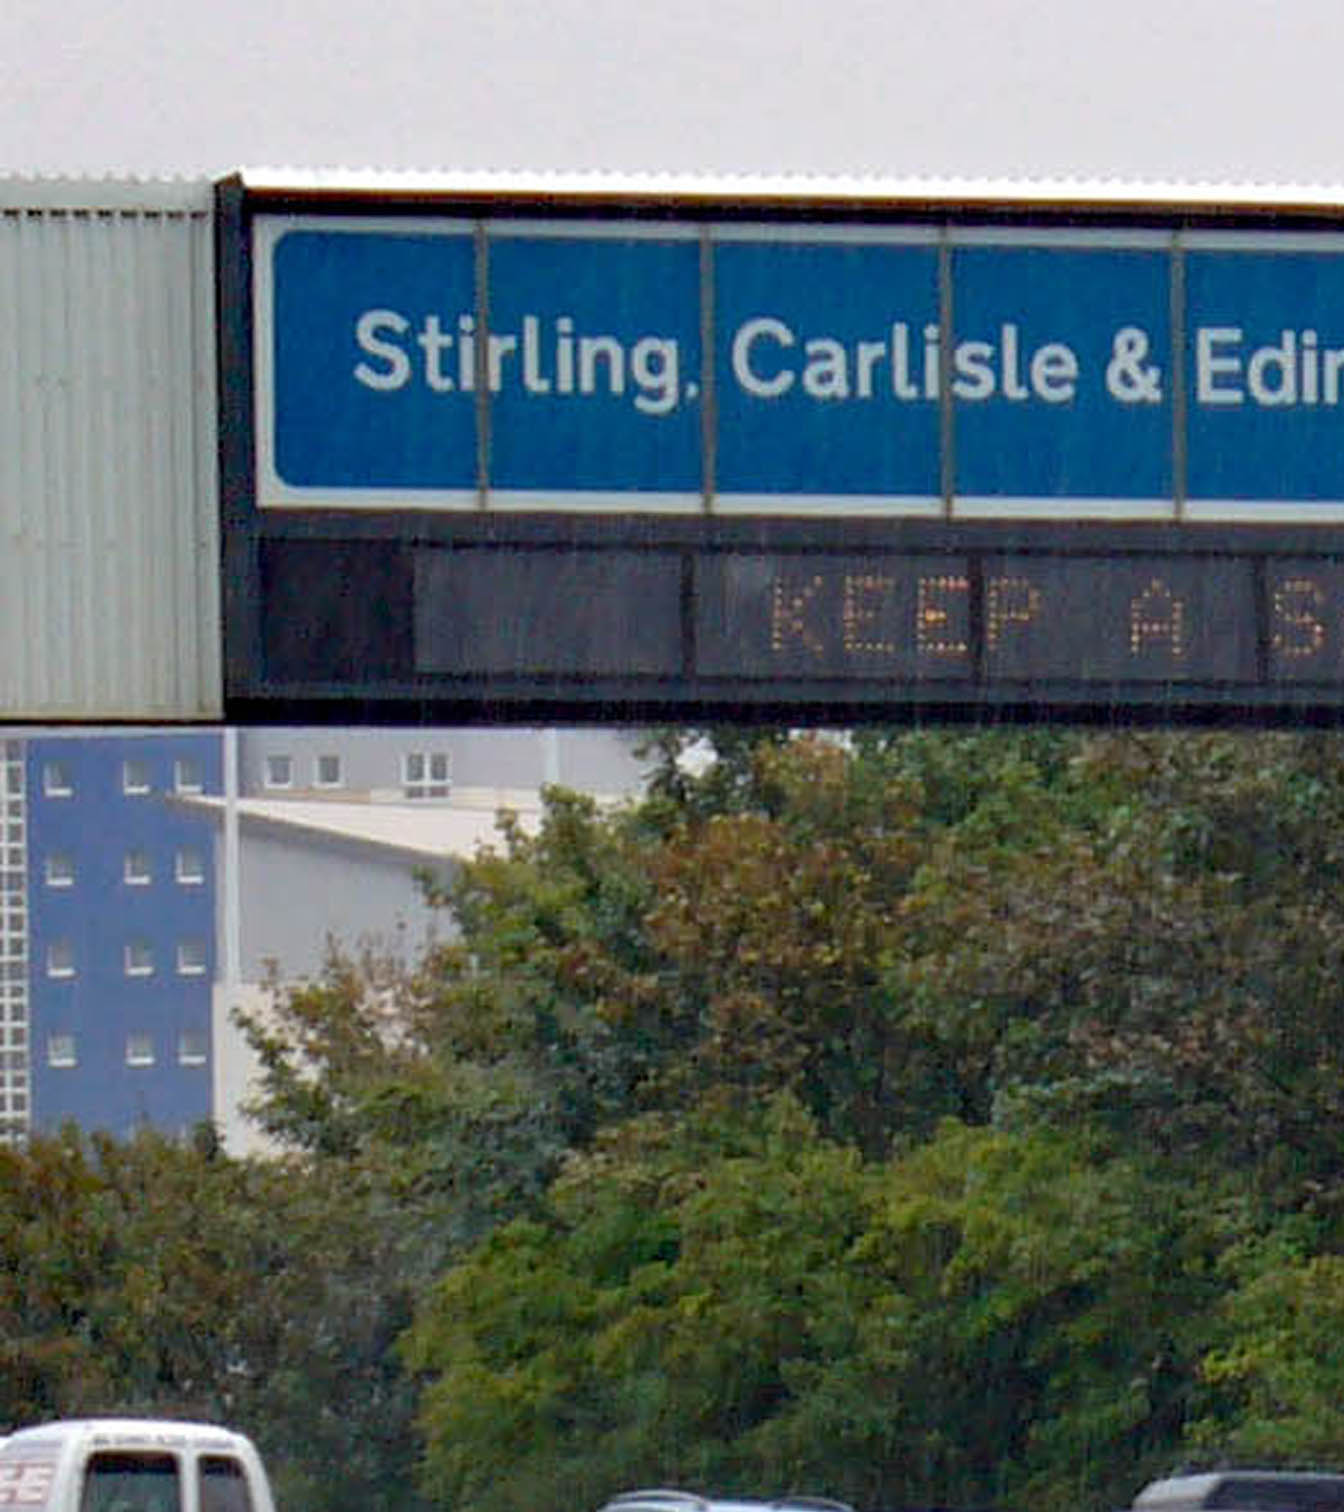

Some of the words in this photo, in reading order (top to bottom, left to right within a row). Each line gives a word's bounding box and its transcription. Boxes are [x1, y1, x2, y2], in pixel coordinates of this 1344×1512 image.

[732, 318, 1078, 401] Carlisle
[1105, 327, 1163, 403] &
[766, 576, 1038, 652] KEEP
[1131, 579, 1182, 656] A
